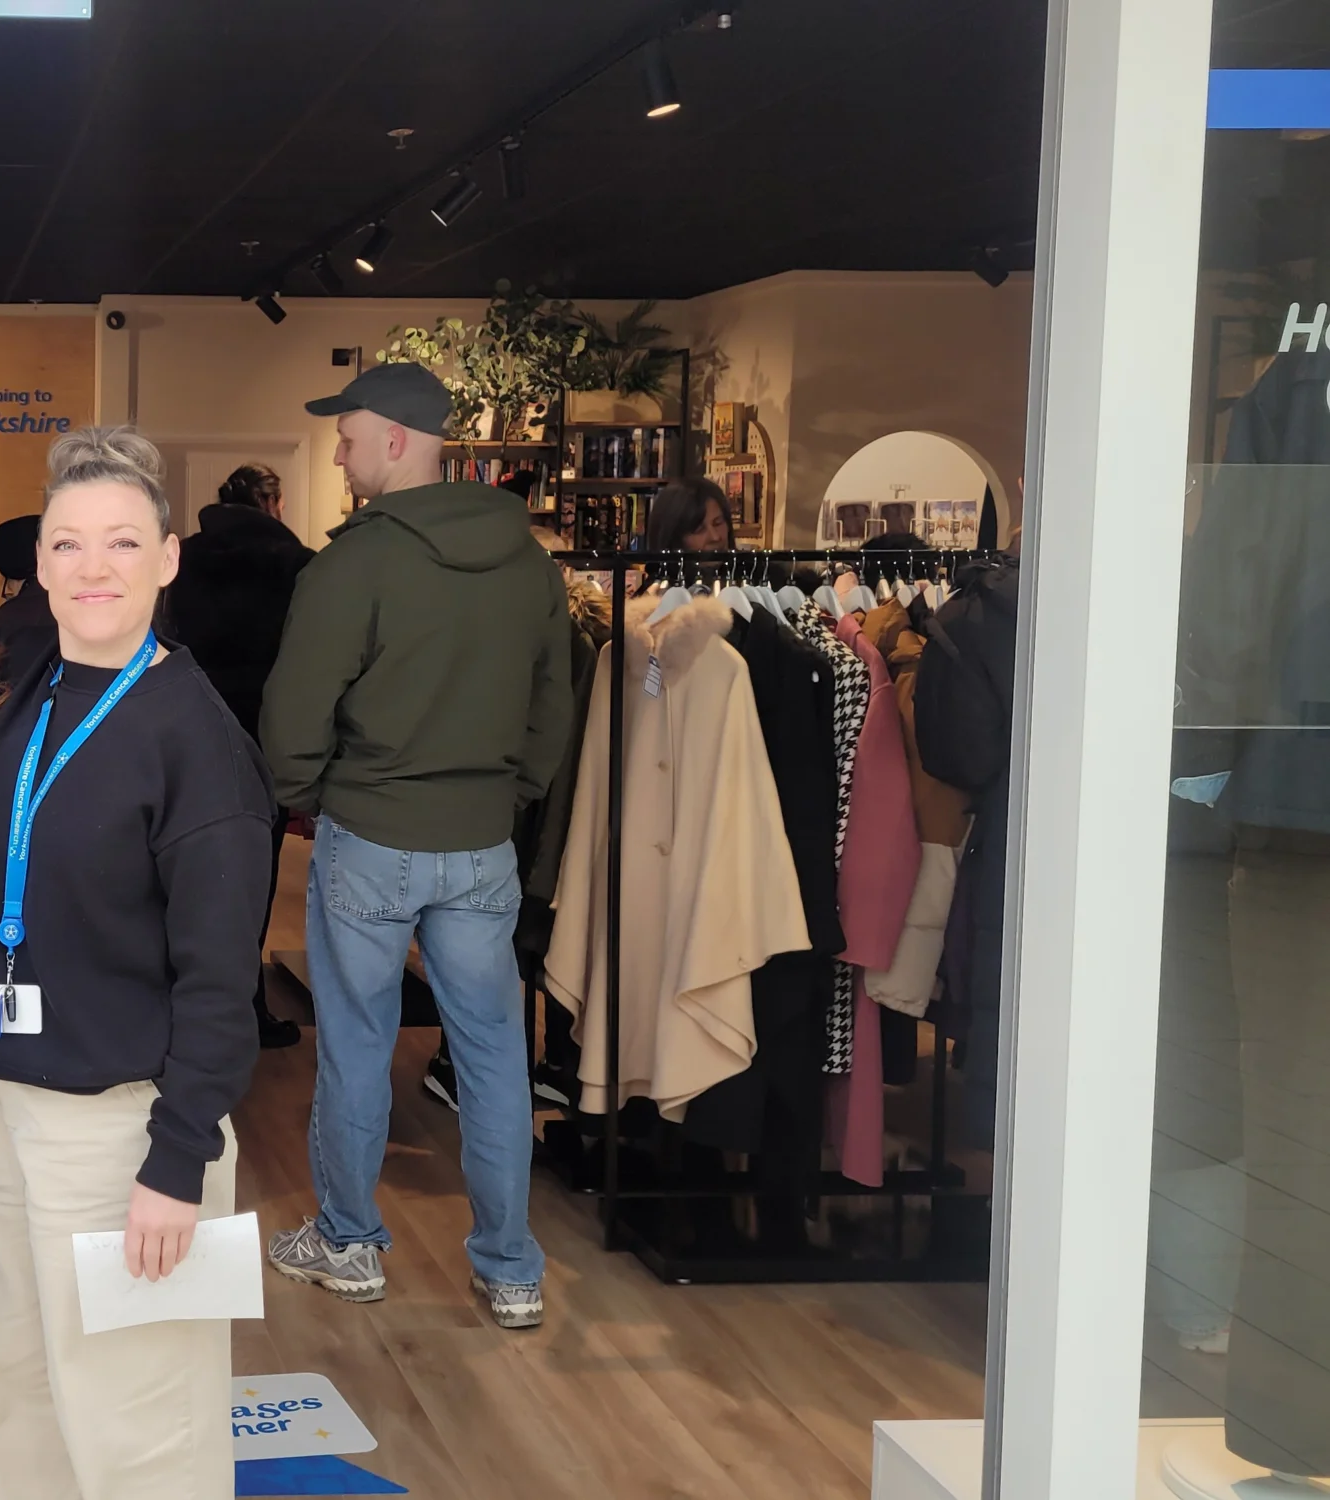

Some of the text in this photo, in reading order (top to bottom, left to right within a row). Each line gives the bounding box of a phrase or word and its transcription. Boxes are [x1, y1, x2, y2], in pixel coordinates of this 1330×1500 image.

[1278, 302, 1330, 353] H
[34, 389, 53, 402] to
[84, 653, 149, 730] Yorkshire Cancer Research
[12, 745, 38, 848] Yorkshire Cancer Research
[19, 823, 30, 861] Yorkshire
